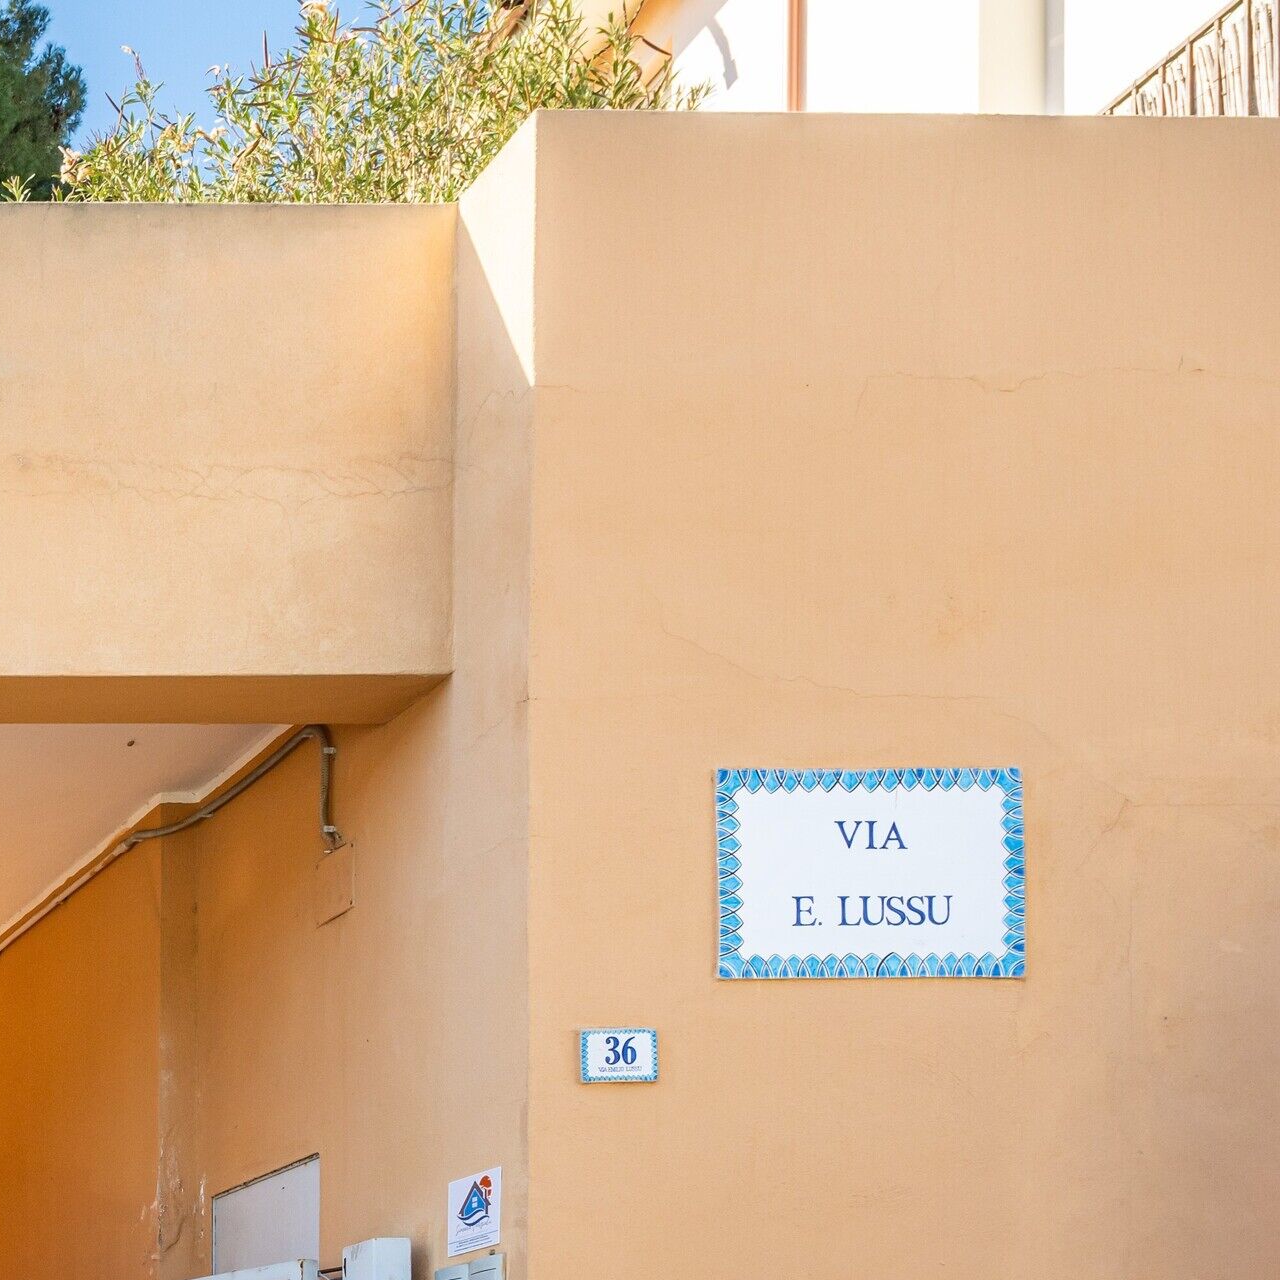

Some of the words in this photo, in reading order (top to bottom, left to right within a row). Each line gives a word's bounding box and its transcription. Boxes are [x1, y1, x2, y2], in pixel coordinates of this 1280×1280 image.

[834, 820, 908, 850] VIA
[791, 895, 823, 927] E.
[837, 895, 953, 927] LUSSU
[605, 1036, 637, 1065] 36
